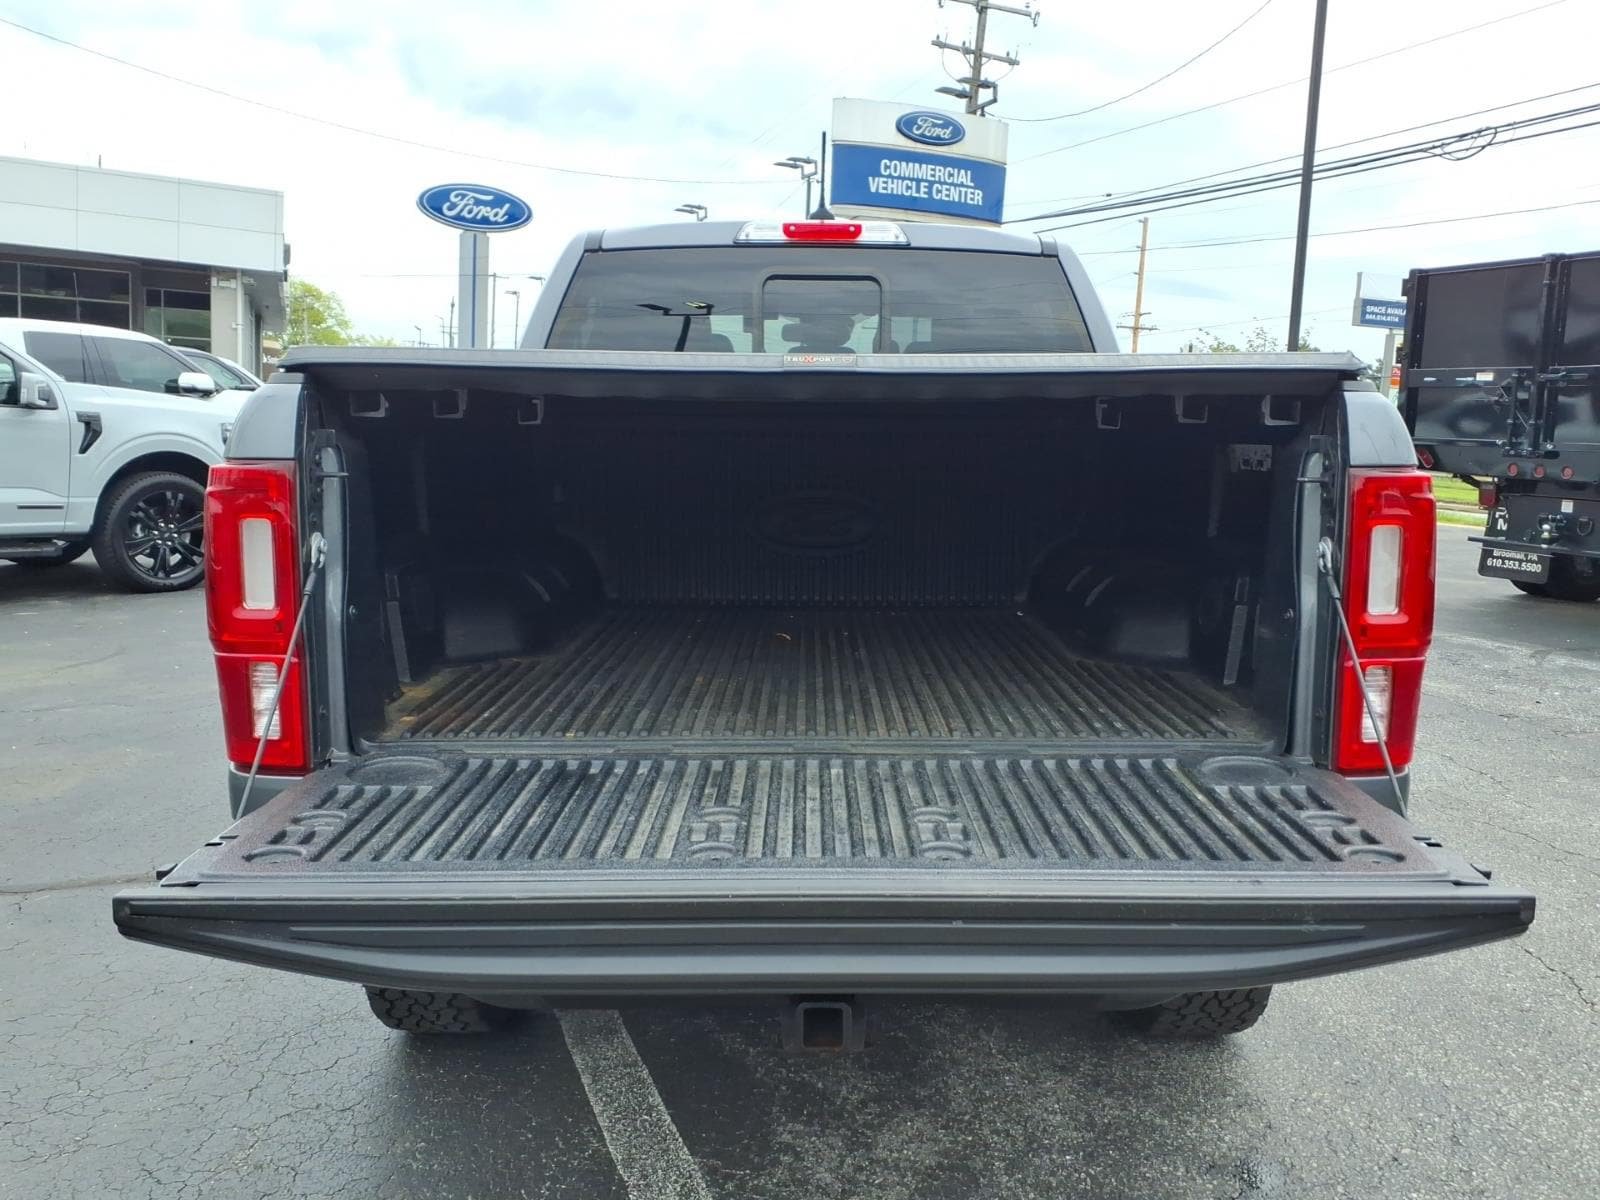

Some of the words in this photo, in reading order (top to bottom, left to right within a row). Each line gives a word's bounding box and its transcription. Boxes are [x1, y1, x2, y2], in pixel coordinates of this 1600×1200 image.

[912, 115, 952, 139] Ford
[880, 159, 975, 187] COMMERCIAL
[868, 176, 929, 199] VEHICLE
[932, 184, 983, 206] CENTER
[442, 190, 511, 222] Ford
[1366, 305, 1387, 314] SPACE
[1486, 557, 1542, 573] 610.353.5500
